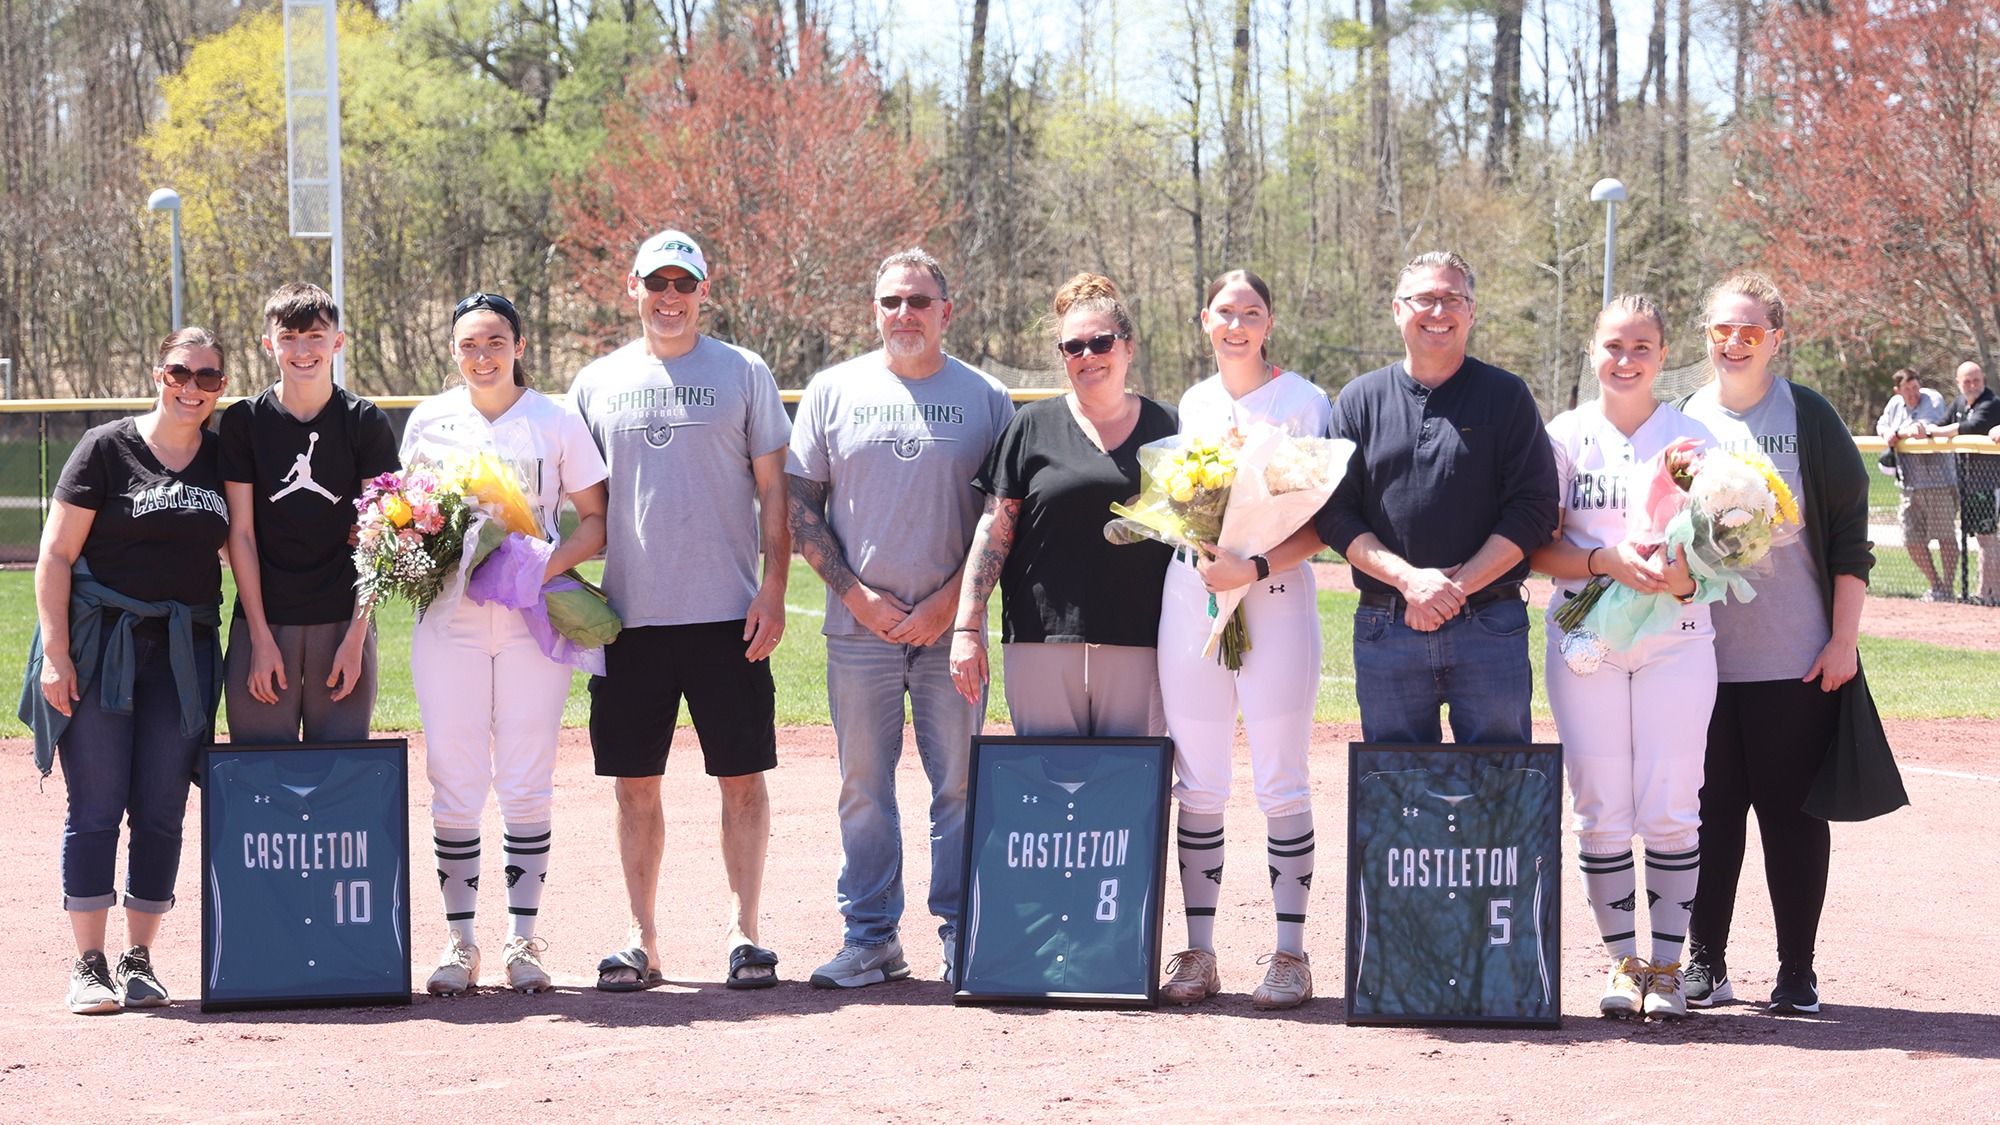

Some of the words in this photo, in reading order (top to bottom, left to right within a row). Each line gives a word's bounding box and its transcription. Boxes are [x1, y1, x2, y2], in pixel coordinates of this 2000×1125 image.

[606, 385, 716, 414] SPARTANS
[633, 408, 685, 419] SOFTBALL
[852, 403, 964, 425] SPARTANS
[880, 423, 935, 432] SOFTBALL
[243, 831, 368, 869] CASTLETON
[1007, 829, 1129, 868] CASTLETON
[1388, 847, 1518, 887] CASTLETON
[333, 880, 372, 925] 10
[1095, 878, 1119, 922] 8
[1489, 899, 1512, 946] 5
